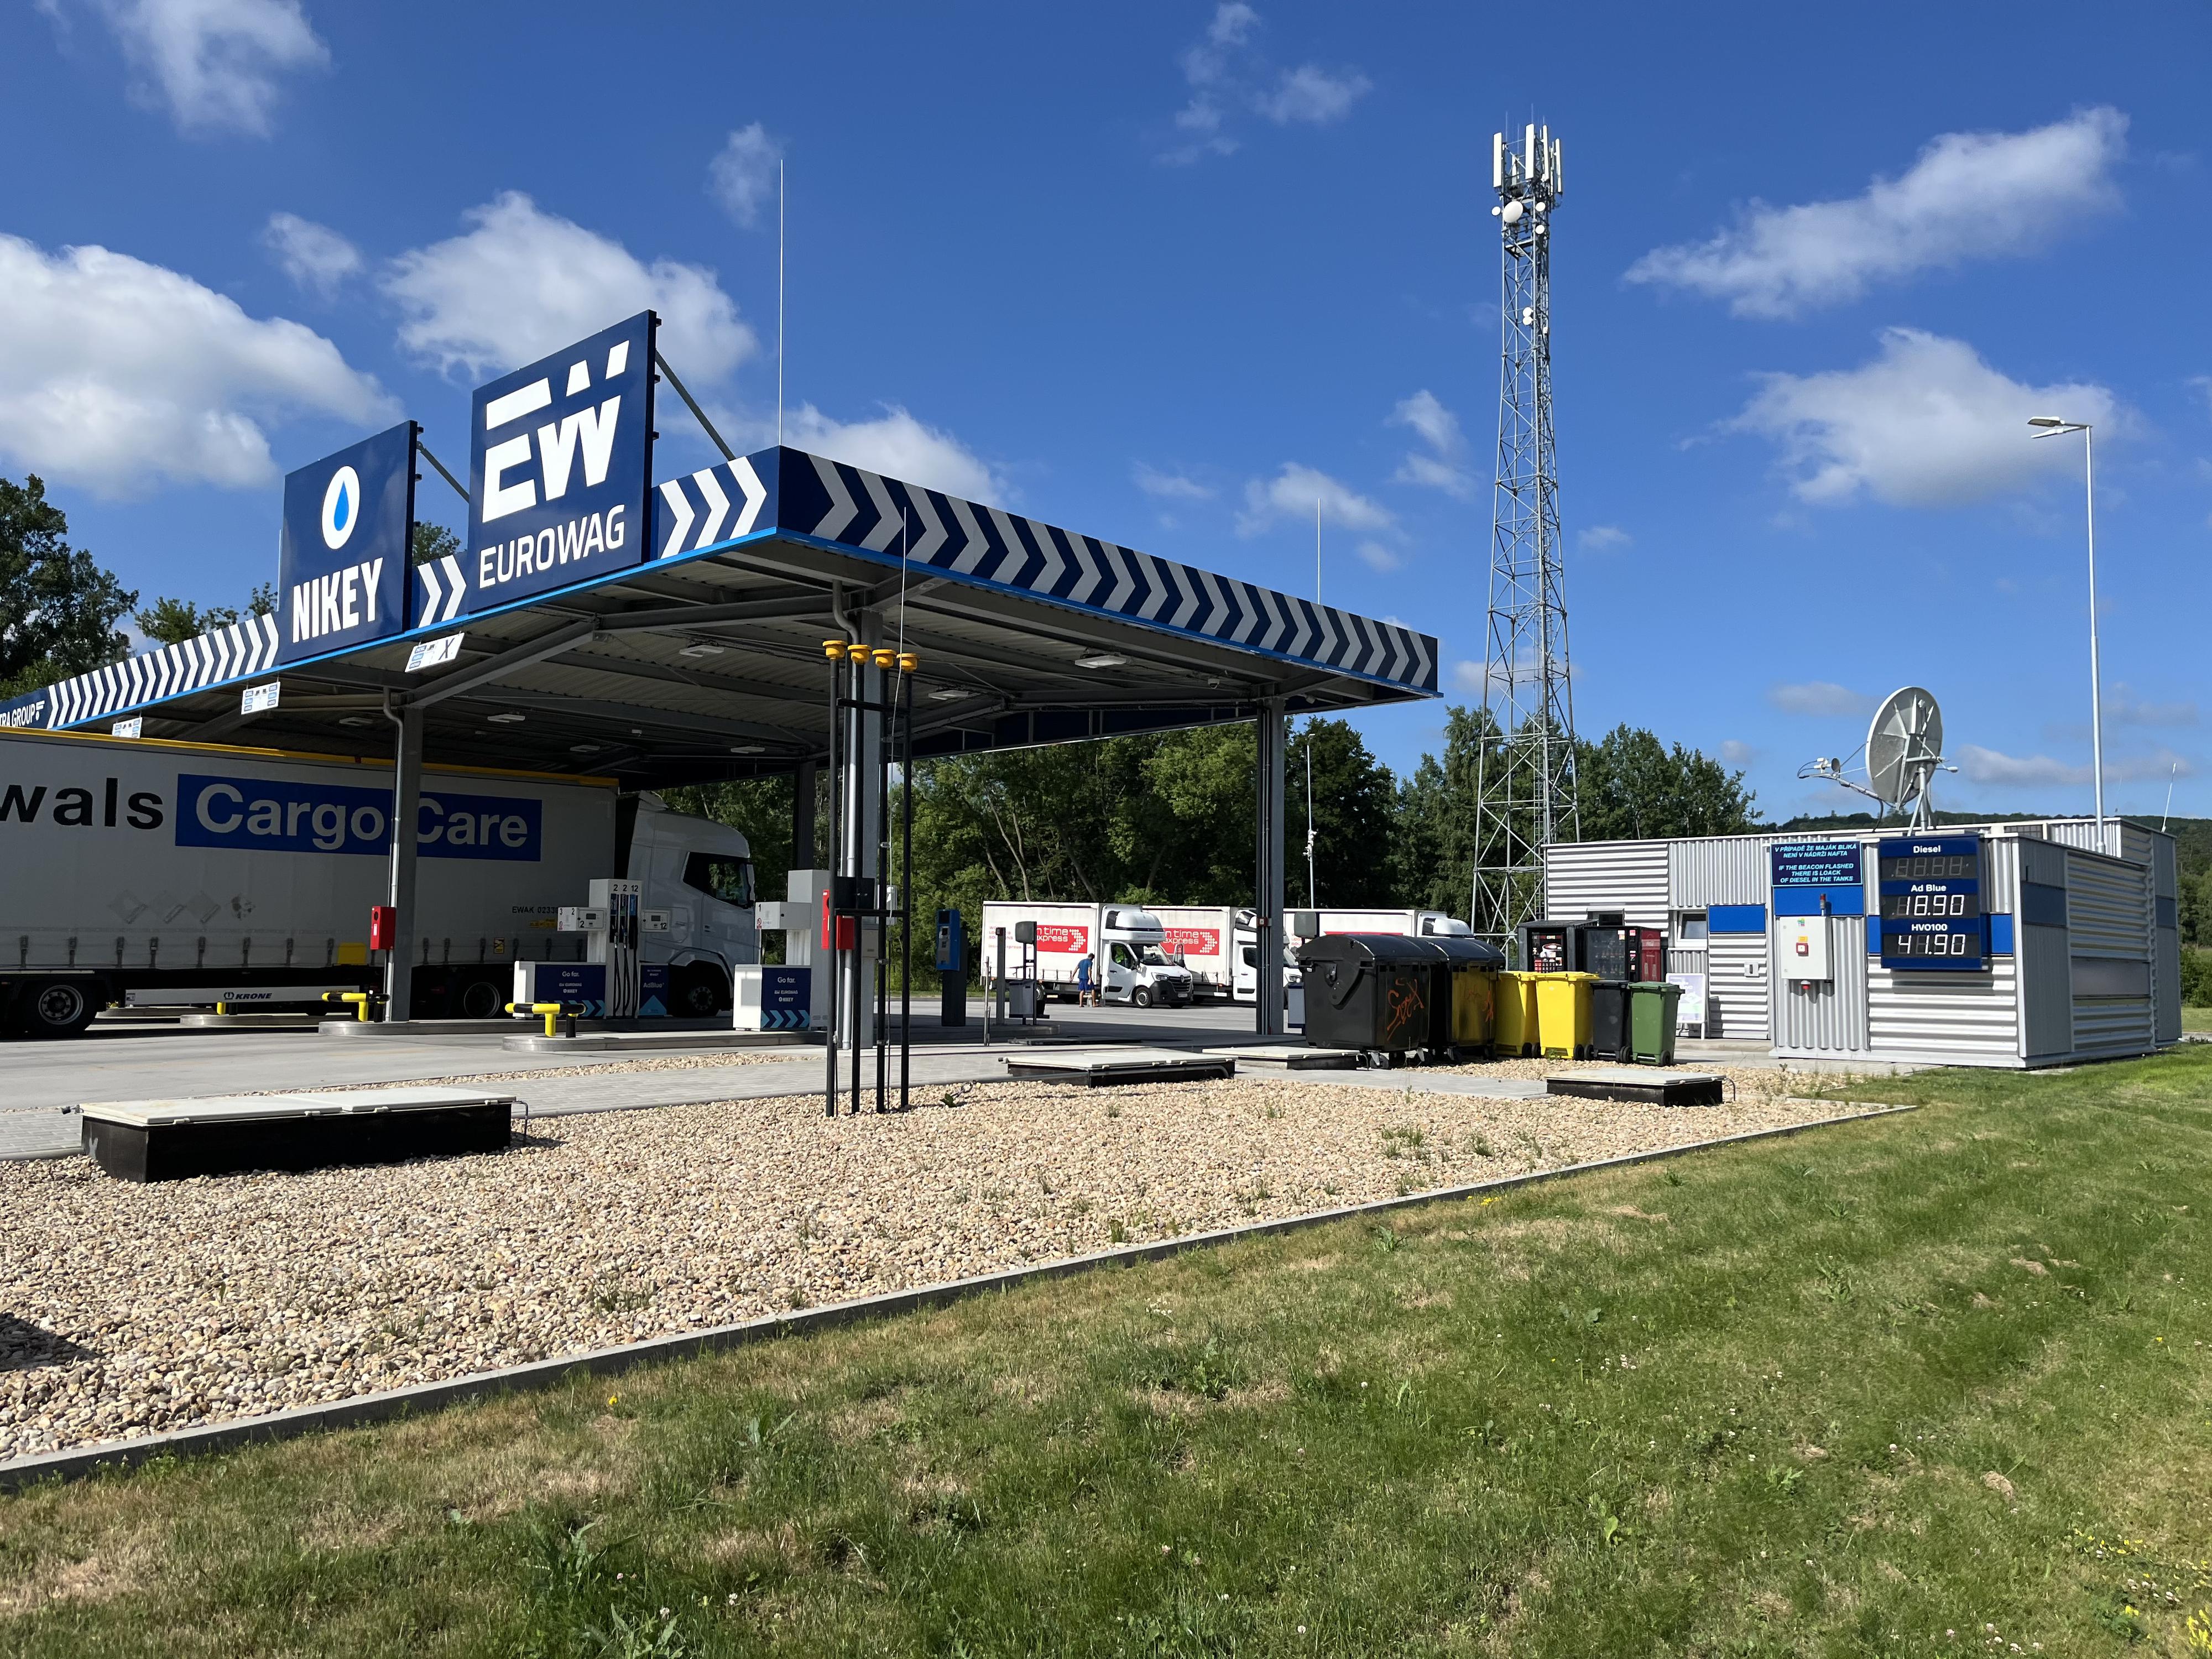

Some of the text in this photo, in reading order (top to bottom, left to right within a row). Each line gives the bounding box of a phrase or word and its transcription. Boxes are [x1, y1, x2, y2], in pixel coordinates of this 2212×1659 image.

[478, 503, 625, 589] EUROWAG
[292, 556, 384, 644] NIKEY
[11, 703, 35, 728] GROUP
[196, 783, 385, 850] Cargo
[416, 797, 528, 848] Care
[1913, 845, 1941, 854] Diesel
[1926, 884, 1947, 892] Blue
[758, 904, 761, 912] 1
[1906, 894, 1965, 916] 18.90
[1044, 927, 1068, 936] time
[1173, 930, 1199, 938] time
[1911, 923, 1948, 931] HVO100
[1898, 934, 1966, 955] 41.90
